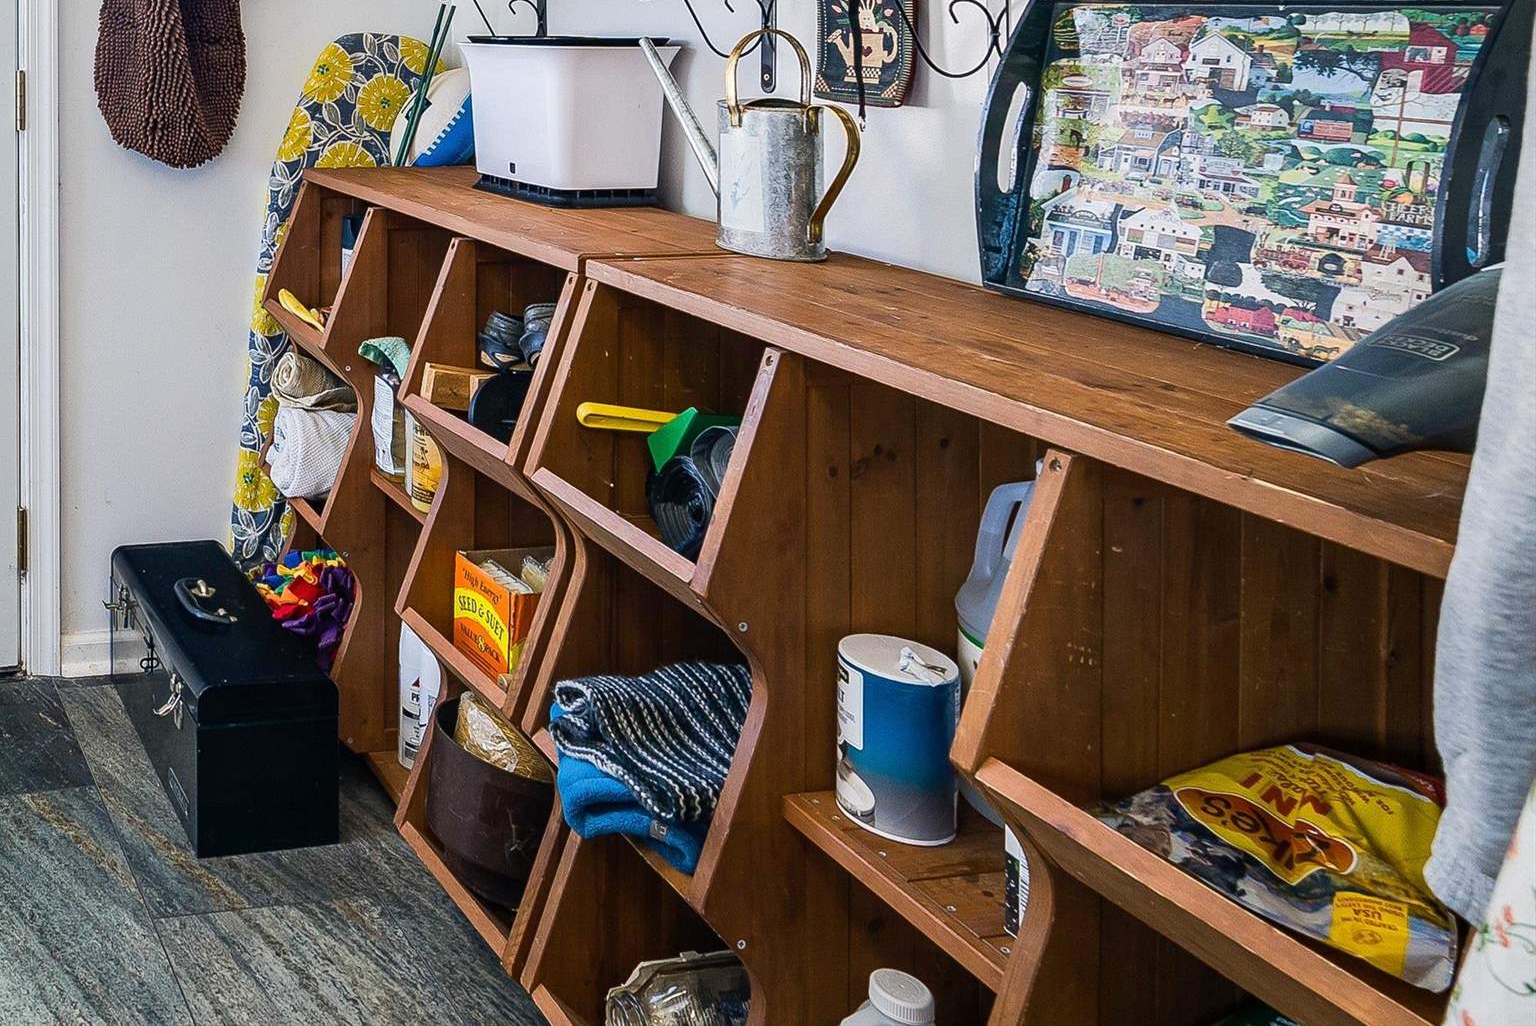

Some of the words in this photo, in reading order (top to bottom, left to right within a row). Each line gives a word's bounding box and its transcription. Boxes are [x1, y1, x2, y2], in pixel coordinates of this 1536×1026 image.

[458, 595, 477, 614] SEED
[478, 604, 485, 618] &
[486, 610, 505, 641] SUET
[460, 622, 479, 643] VALUE
[478, 635, 486, 652] 8
[485, 646, 501, 663] PACK
[1352, 908, 1382, 921] USA
